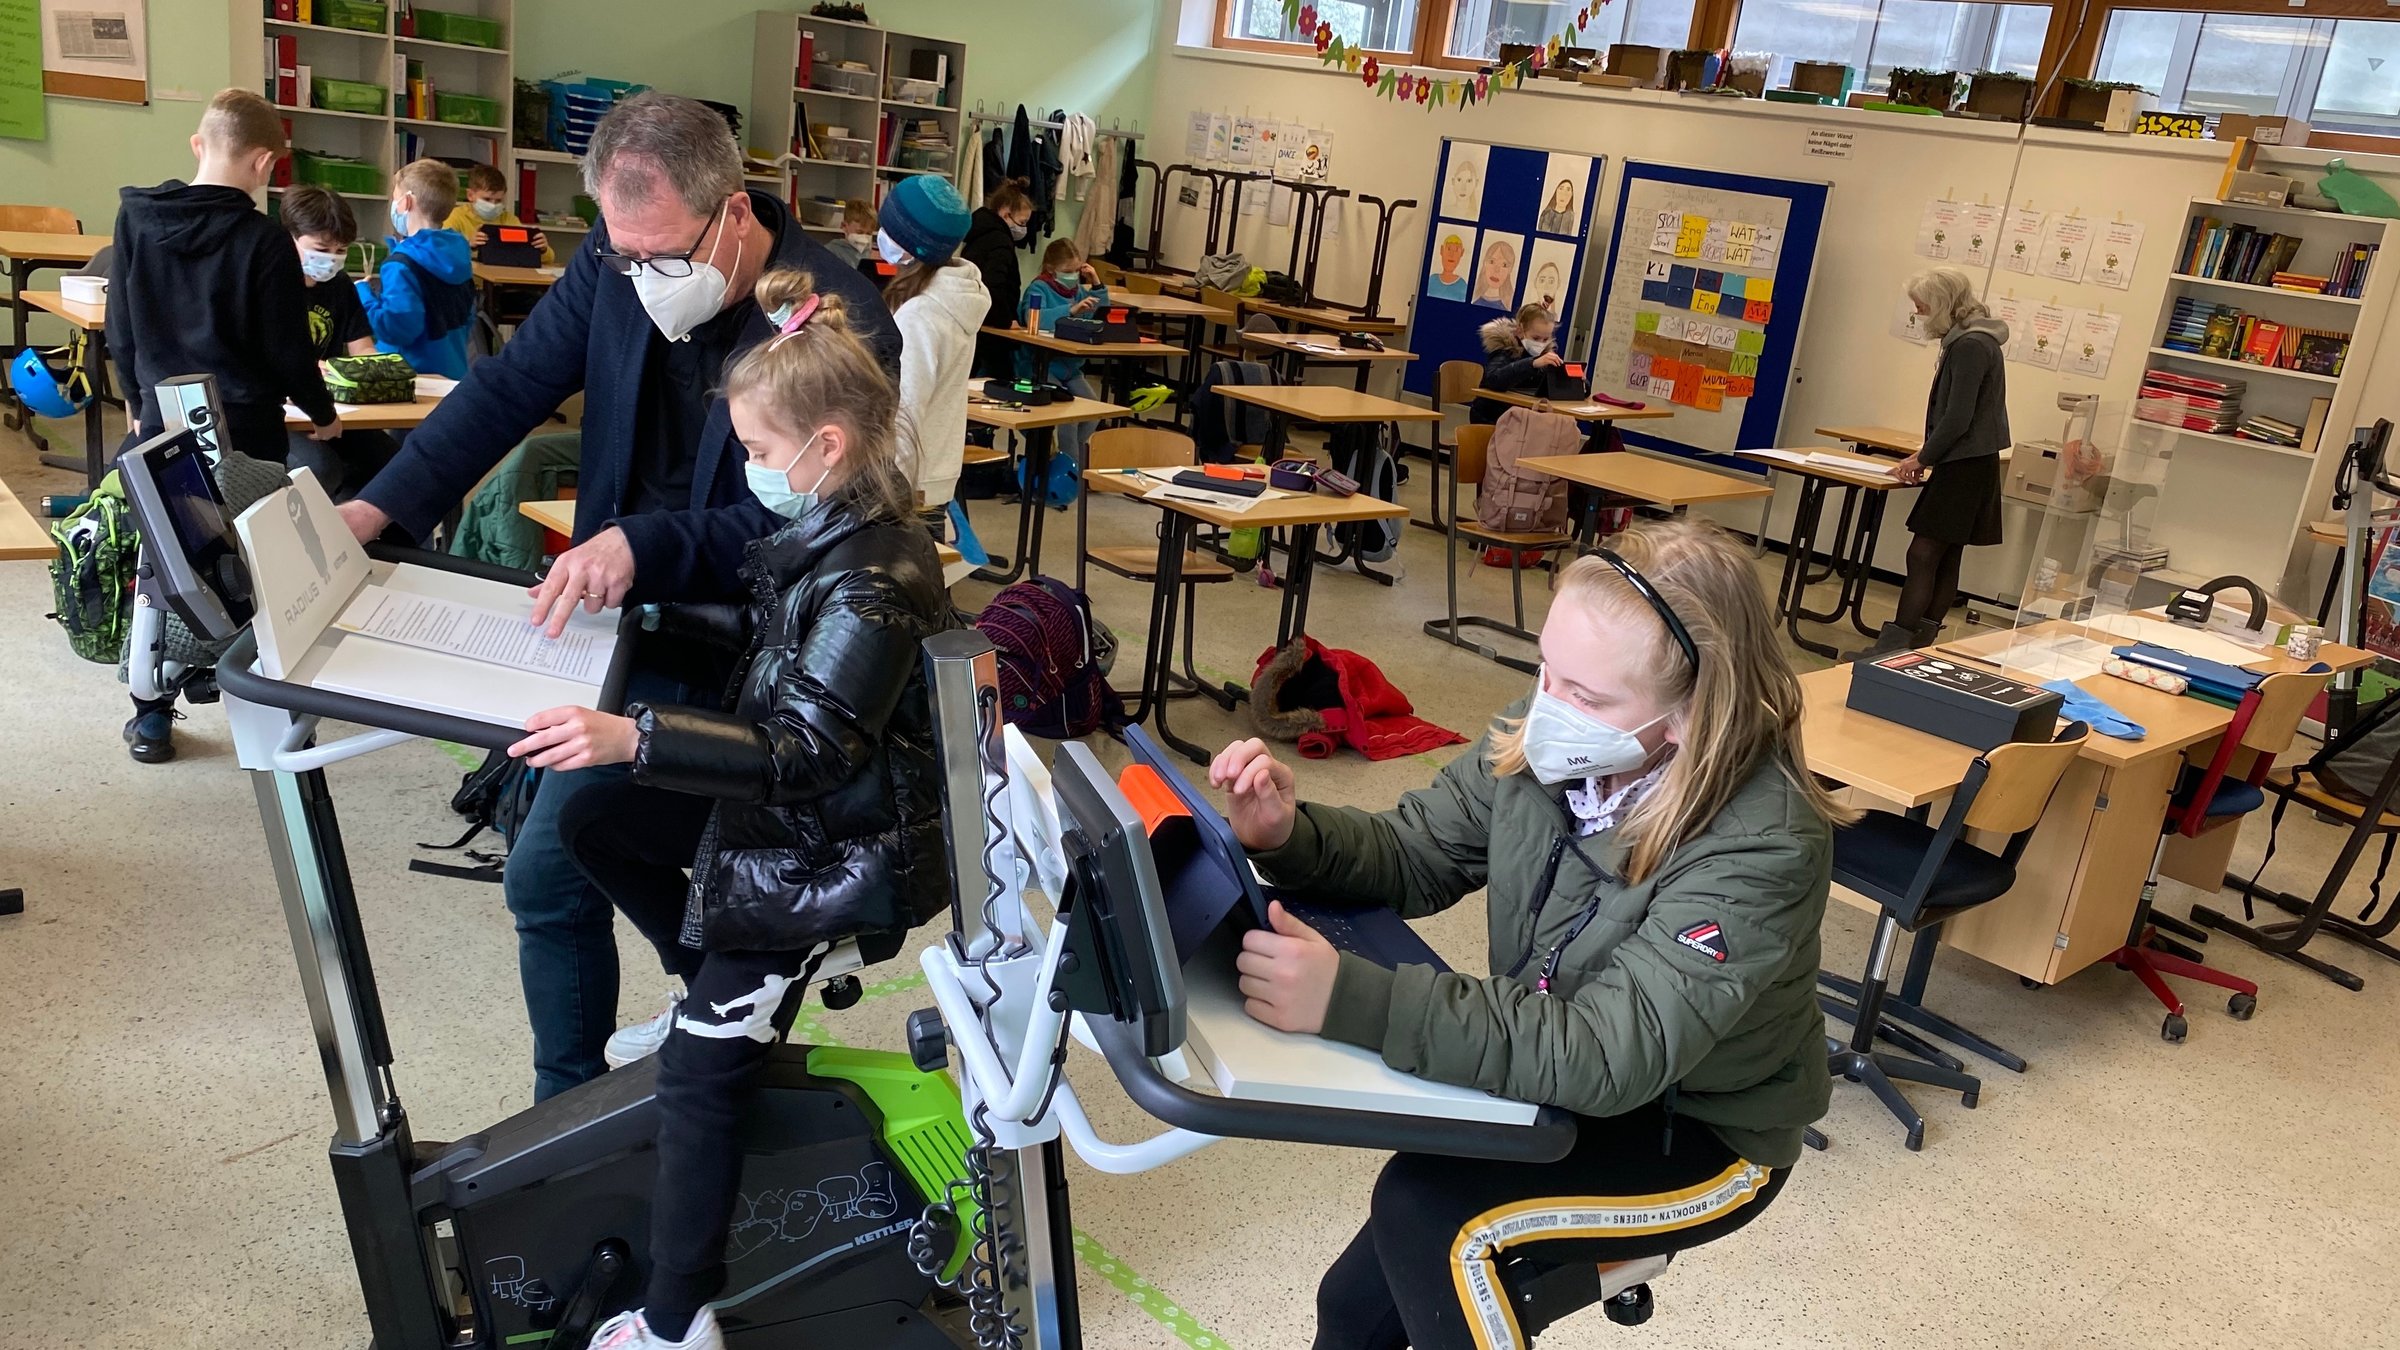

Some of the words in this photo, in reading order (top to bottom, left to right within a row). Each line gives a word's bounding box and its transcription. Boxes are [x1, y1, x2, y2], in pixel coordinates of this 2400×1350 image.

[284, 581, 320, 625] RADIUS
[1567, 755, 1592, 766] MK
[1677, 934, 1719, 957] SUPERDRY
[1613, 1214, 1649, 1224] QUEENS
[1659, 1201, 1708, 1221] BROOKLYN
[854, 1217, 914, 1246] KETTLER
